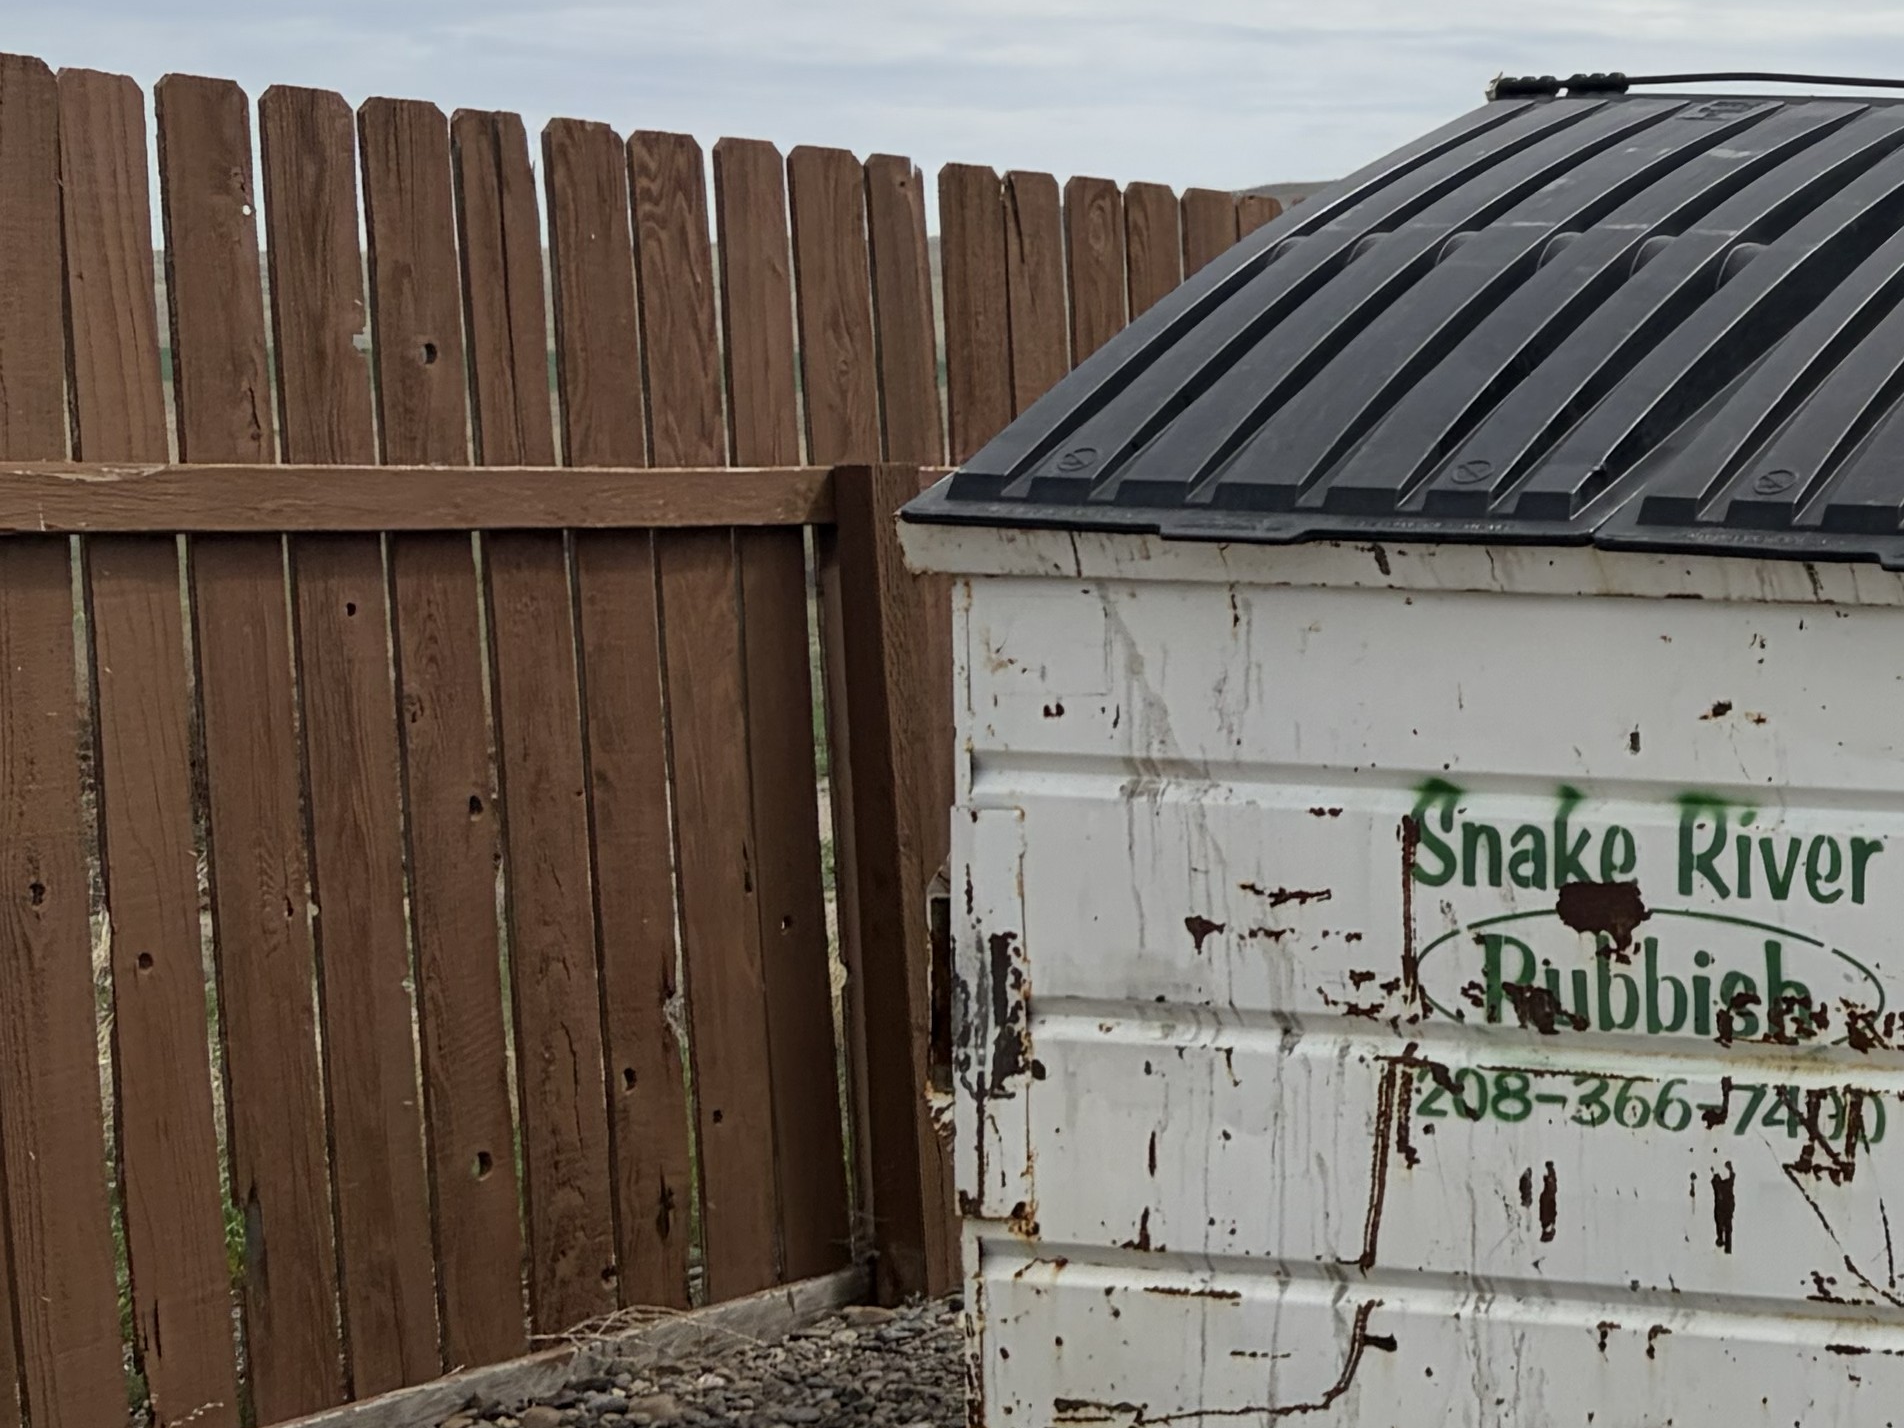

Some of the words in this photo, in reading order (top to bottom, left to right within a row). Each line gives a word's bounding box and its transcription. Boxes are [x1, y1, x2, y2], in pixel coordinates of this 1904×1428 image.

[1411, 777, 1638, 892] Snake
[1676, 790, 1885, 905] River
[1480, 933, 1814, 1041] Rubbish
